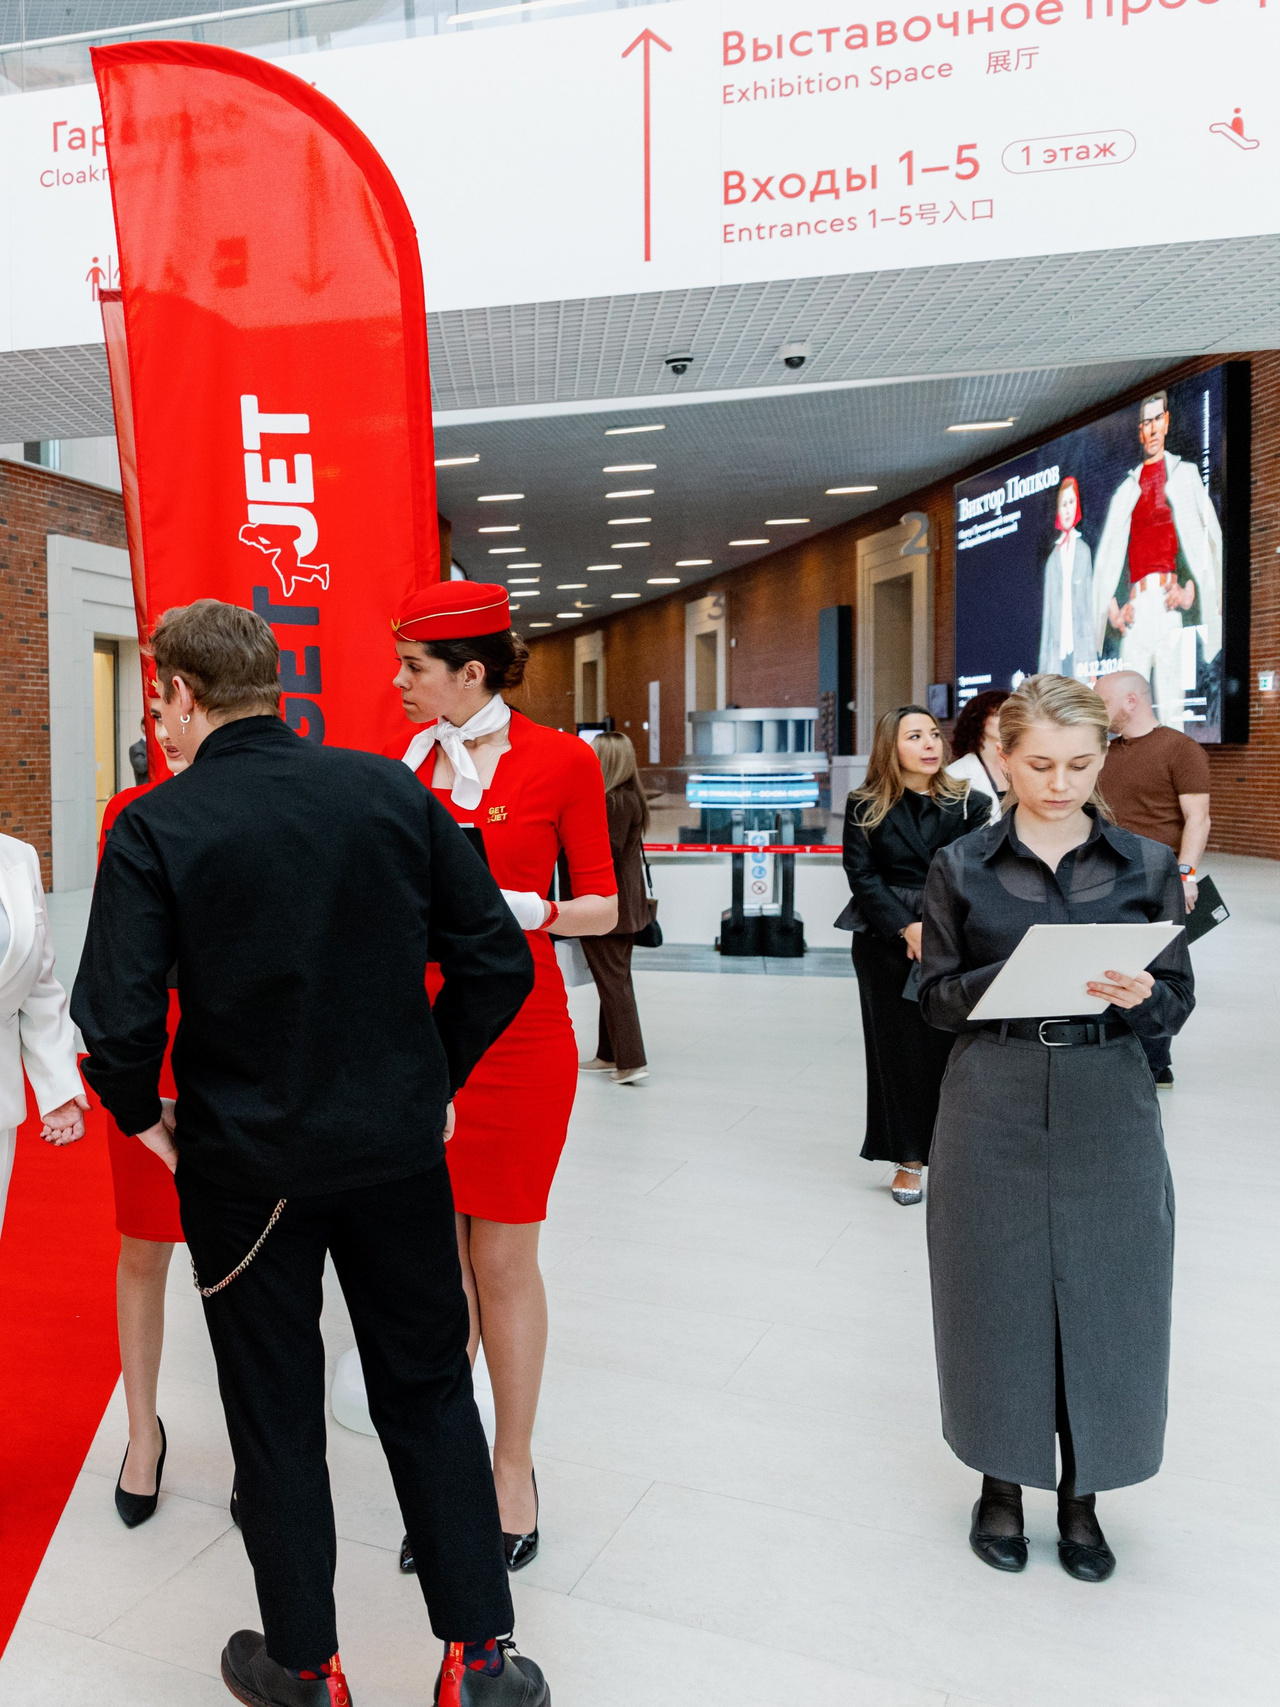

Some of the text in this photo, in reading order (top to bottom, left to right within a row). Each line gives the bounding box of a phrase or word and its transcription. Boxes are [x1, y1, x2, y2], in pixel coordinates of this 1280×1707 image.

[723, 0, 1063, 67] Выставочное
[985, 46, 1040, 75] 展厅
[722, 62, 954, 105] Exhibition Space
[1020, 141, 1117, 166] 1 этаж
[723, 143, 981, 206] Входы 1–5
[722, 214, 858, 244] Entrances
[1005, 465, 1061, 504] Попков
[899, 511, 931, 556] 2
[488, 806, 506, 815] GET
